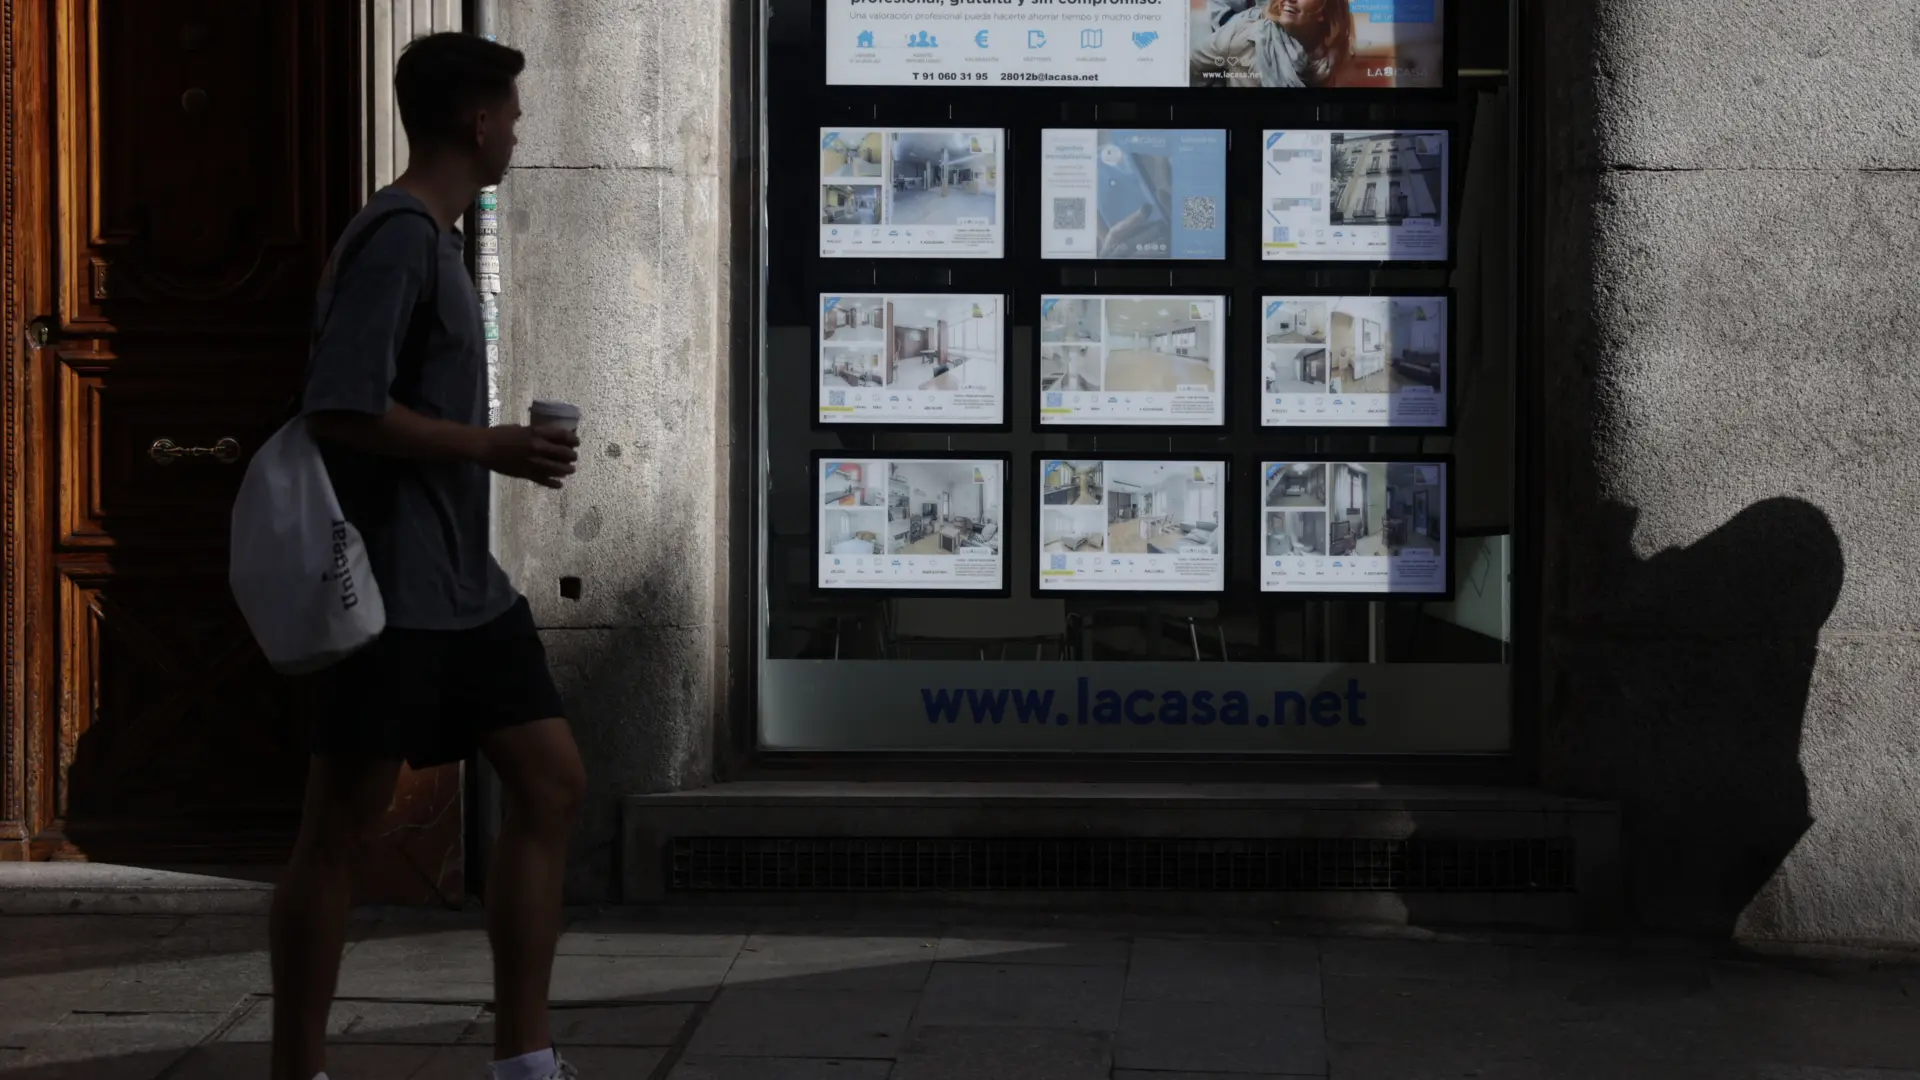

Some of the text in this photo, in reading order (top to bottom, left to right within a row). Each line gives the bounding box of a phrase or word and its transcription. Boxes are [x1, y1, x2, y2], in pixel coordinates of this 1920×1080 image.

[849, 11, 866, 20] Una
[869, 11, 913, 20] valoración
[915, 11, 962, 22] profesional
[964, 11, 991, 22] puede
[993, 12, 1026, 21] hacerte
[1028, 12, 1059, 21] ahorrar
[1061, 12, 1092, 23] tiempo
[1101, 12, 1131, 21] mucho
[912, 72, 1099, 82] T 91 060 31 95 28012b@lacasa.net
[1202, 71, 1263, 79] www.lacasa.net
[323, 519, 359, 611] Unigear
[919, 676, 1368, 727] www.lacasa.net
